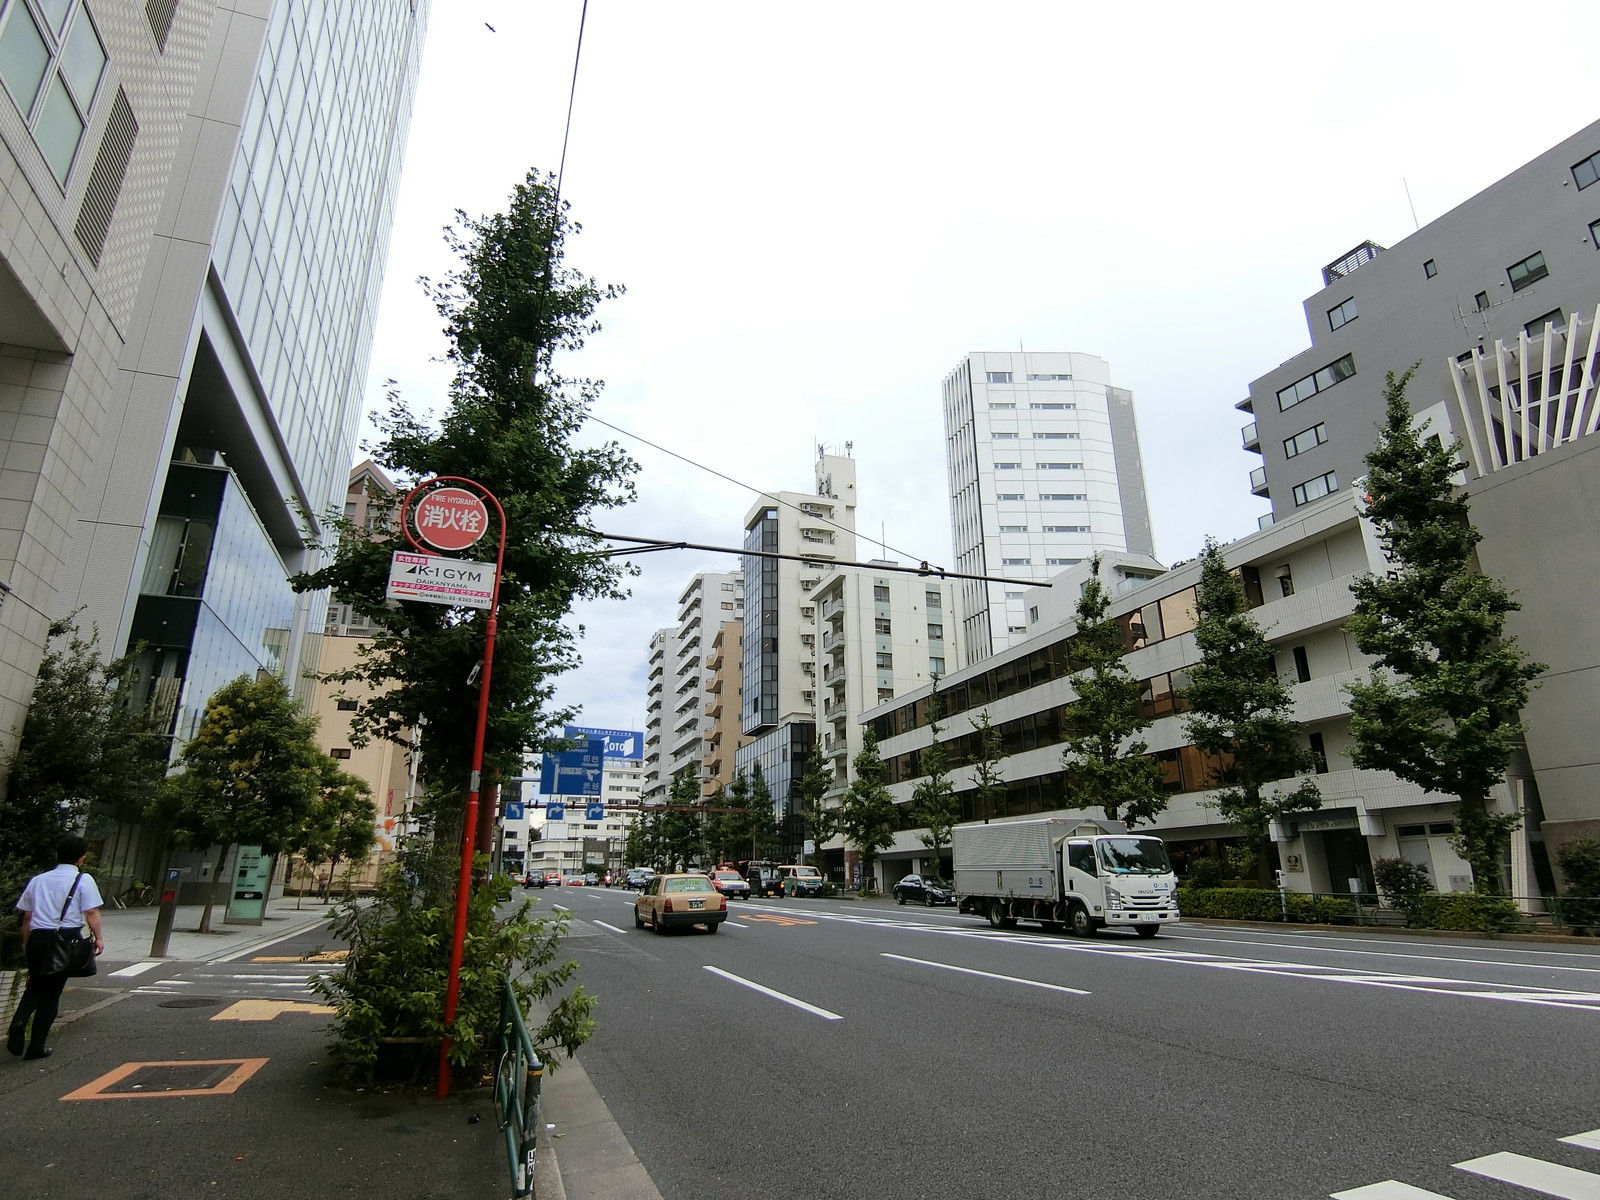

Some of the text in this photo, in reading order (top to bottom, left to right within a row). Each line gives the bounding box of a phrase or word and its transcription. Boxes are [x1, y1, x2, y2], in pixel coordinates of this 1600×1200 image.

[431, 494, 478, 506] FIRE HYDRANT
[422, 504, 482, 533] 消火栓
[418, 565, 482, 582] K-1 GYM
[416, 578, 468, 589] DAIKANYAMA
[583, 754, 599, 763] 初台
[169, 871, 178, 879] P
